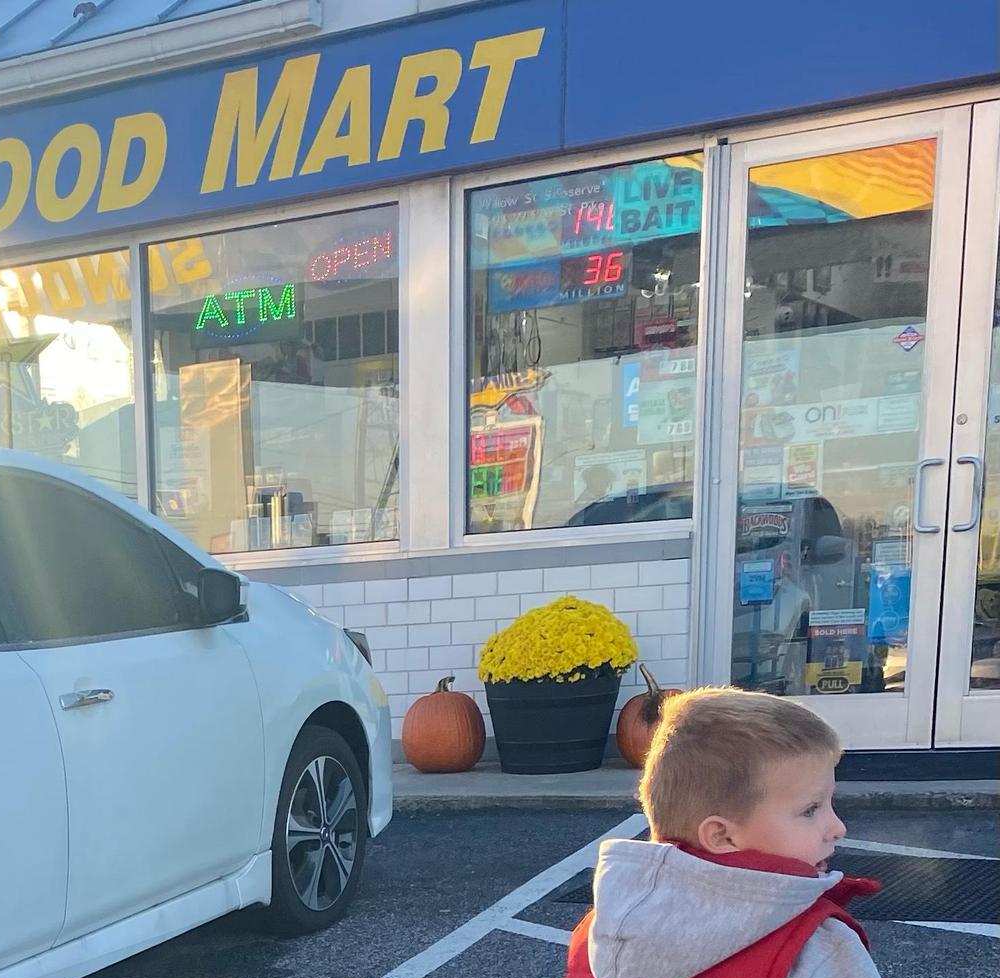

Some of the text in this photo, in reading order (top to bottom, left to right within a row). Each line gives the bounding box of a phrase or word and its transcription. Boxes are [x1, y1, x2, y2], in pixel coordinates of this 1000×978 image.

[200, 27, 546, 194] MART
[620, 168, 696, 234] LIVE BAIT
[311, 236, 393, 282] OPEN
[583, 251, 624, 285] 36
[196, 283, 297, 330] ATM
[559, 285, 625, 299] MILLION
[815, 626, 858, 636] SOLD HERE
[821, 678, 844, 690] PULL
